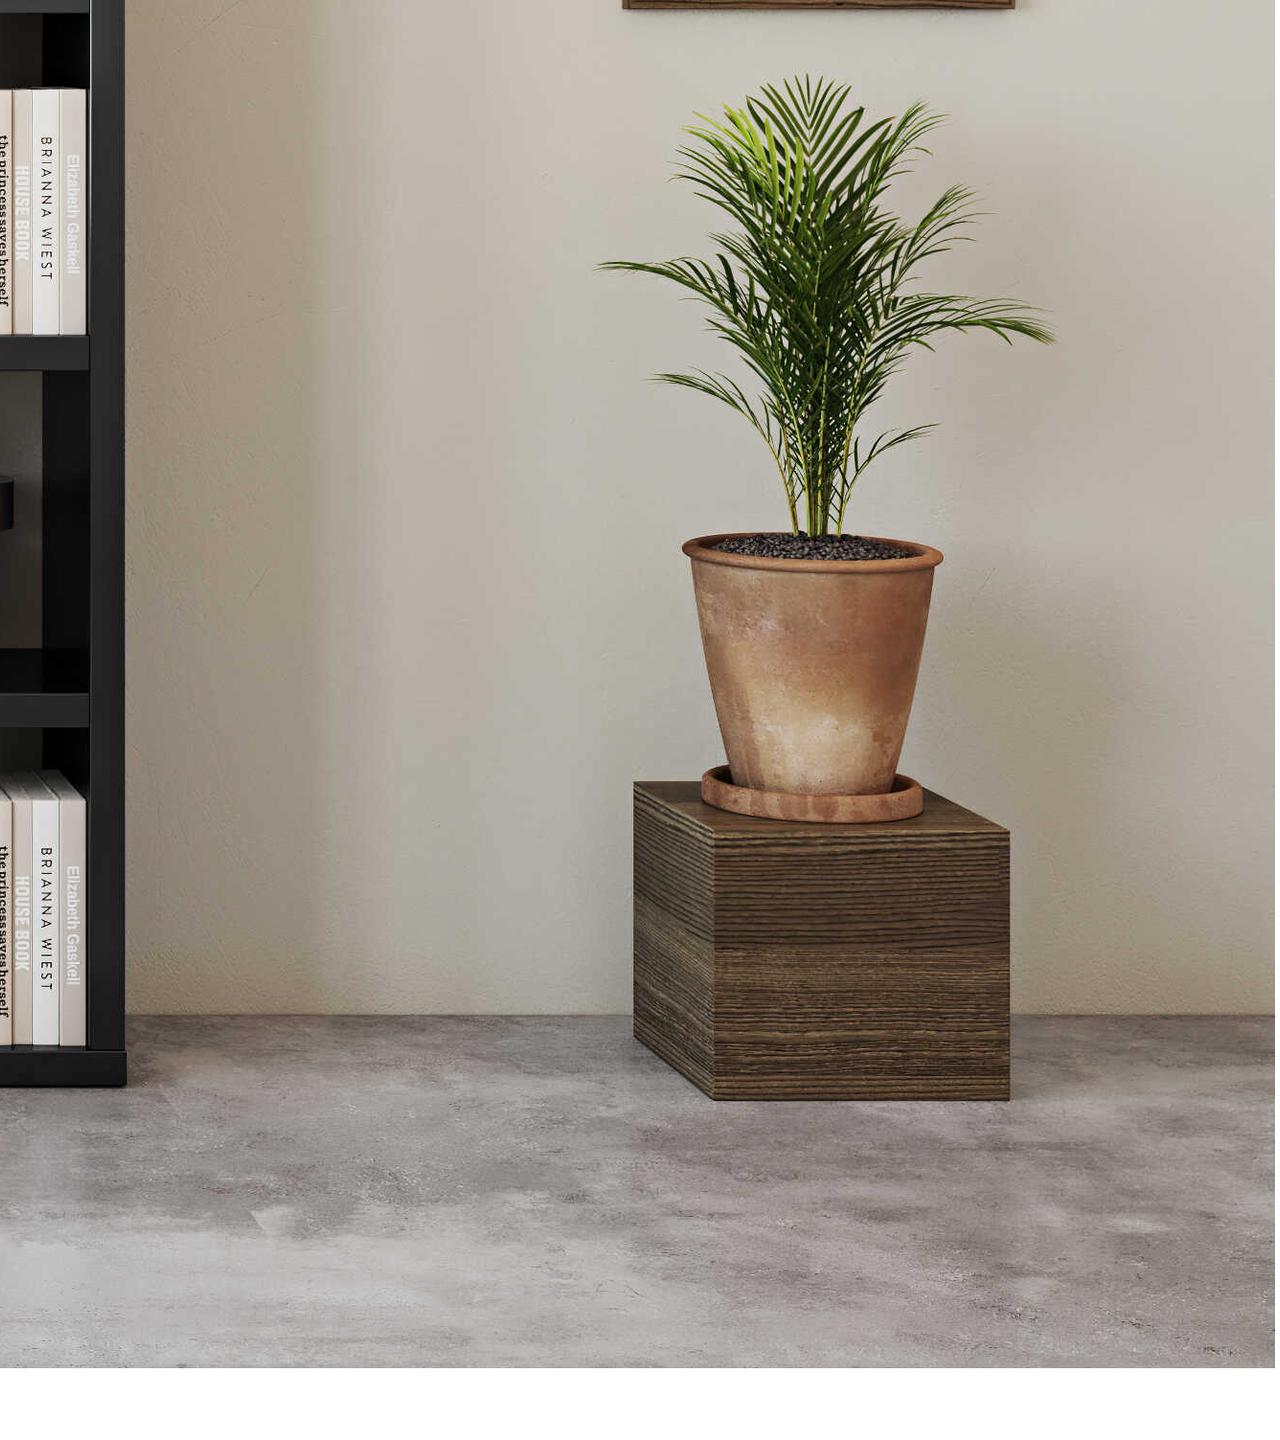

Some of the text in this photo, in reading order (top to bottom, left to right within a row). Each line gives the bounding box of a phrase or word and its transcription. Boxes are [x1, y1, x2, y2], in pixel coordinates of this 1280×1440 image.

[15, 165, 32, 260] HOUSE BOOK
[40, 136, 53, 280] BRIANNA WIEST
[66, 154, 81, 274] Elizabeth Gaskell
[15, 875, 31, 972] HOUSE BOOK
[40, 847, 53, 991] BRIANNA WIEST
[66, 865, 81, 985] Elizabeth Gaskell
